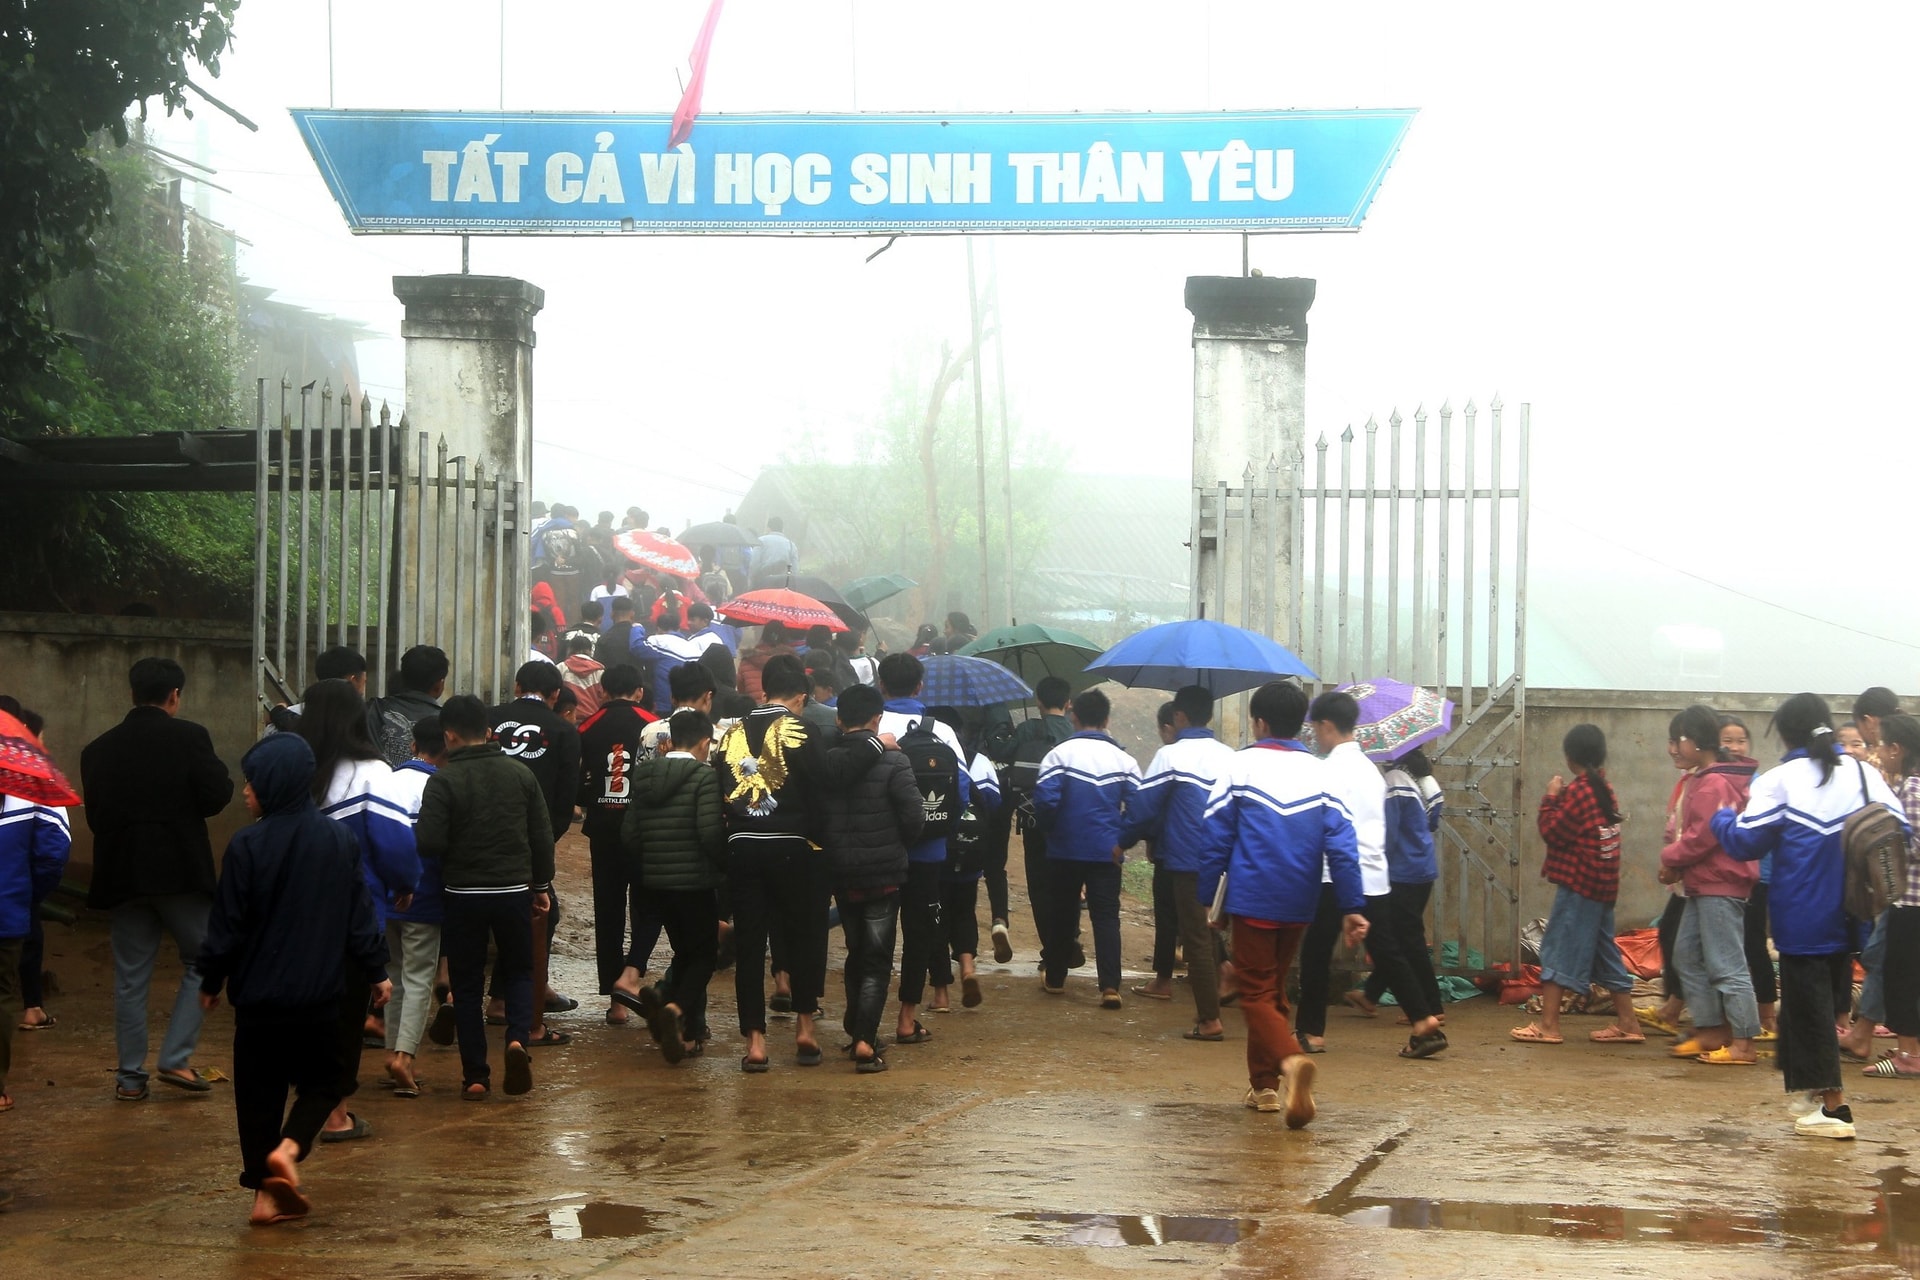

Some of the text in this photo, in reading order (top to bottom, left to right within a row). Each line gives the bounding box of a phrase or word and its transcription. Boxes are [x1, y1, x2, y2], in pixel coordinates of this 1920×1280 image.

[423, 131, 1295, 216] TẤT CẢ VÌ HỌC SINH THÂN YÊU
[925, 811, 948, 821] idas
